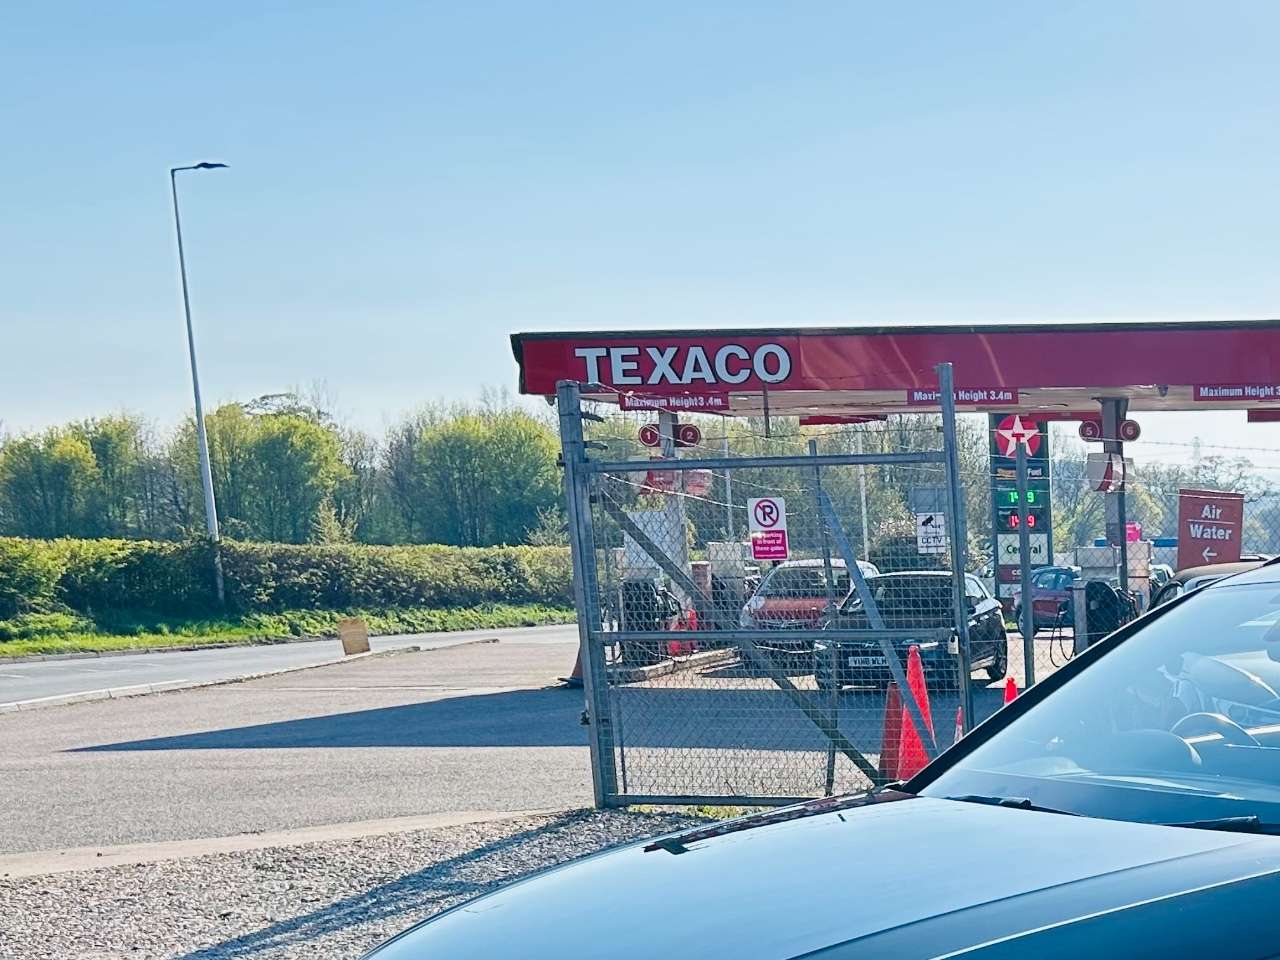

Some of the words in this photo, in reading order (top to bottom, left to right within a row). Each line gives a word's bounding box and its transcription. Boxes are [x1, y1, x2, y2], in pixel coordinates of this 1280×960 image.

[574, 343, 792, 386] TEXACO
[958, 390, 987, 402] Height
[990, 390, 1012, 400] 3.4m
[1200, 387, 1243, 397] Maximum
[1245, 386, 1274, 398] Height
[669, 396, 697, 408] Height
[1201, 504, 1223, 519] Air
[1190, 523, 1232, 540] Water
[922, 536, 942, 544] CCTV
